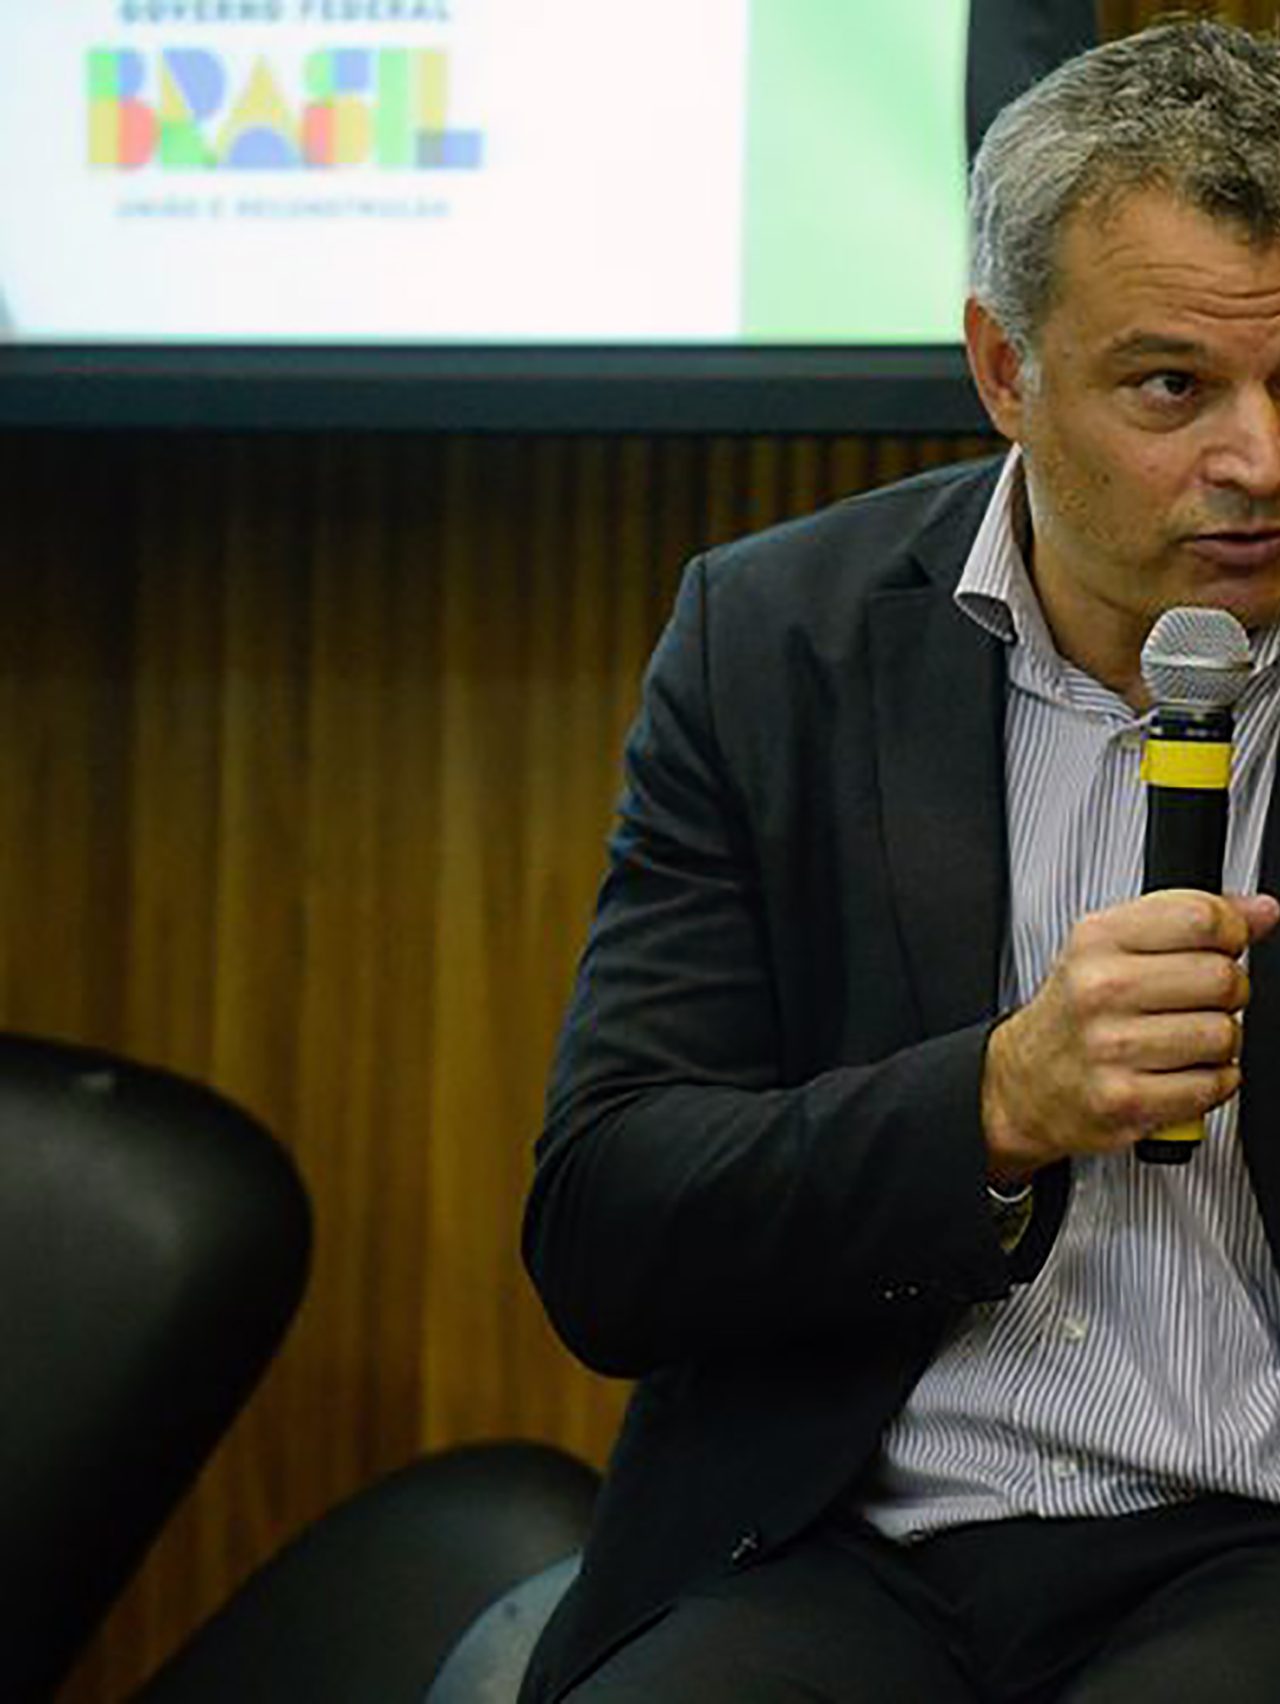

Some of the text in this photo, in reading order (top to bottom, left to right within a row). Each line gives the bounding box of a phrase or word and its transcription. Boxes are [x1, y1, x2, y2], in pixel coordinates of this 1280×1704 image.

[120, 0, 450, 22] GOVERNO FEDERAL
[86, 47, 483, 168] BRASIL
